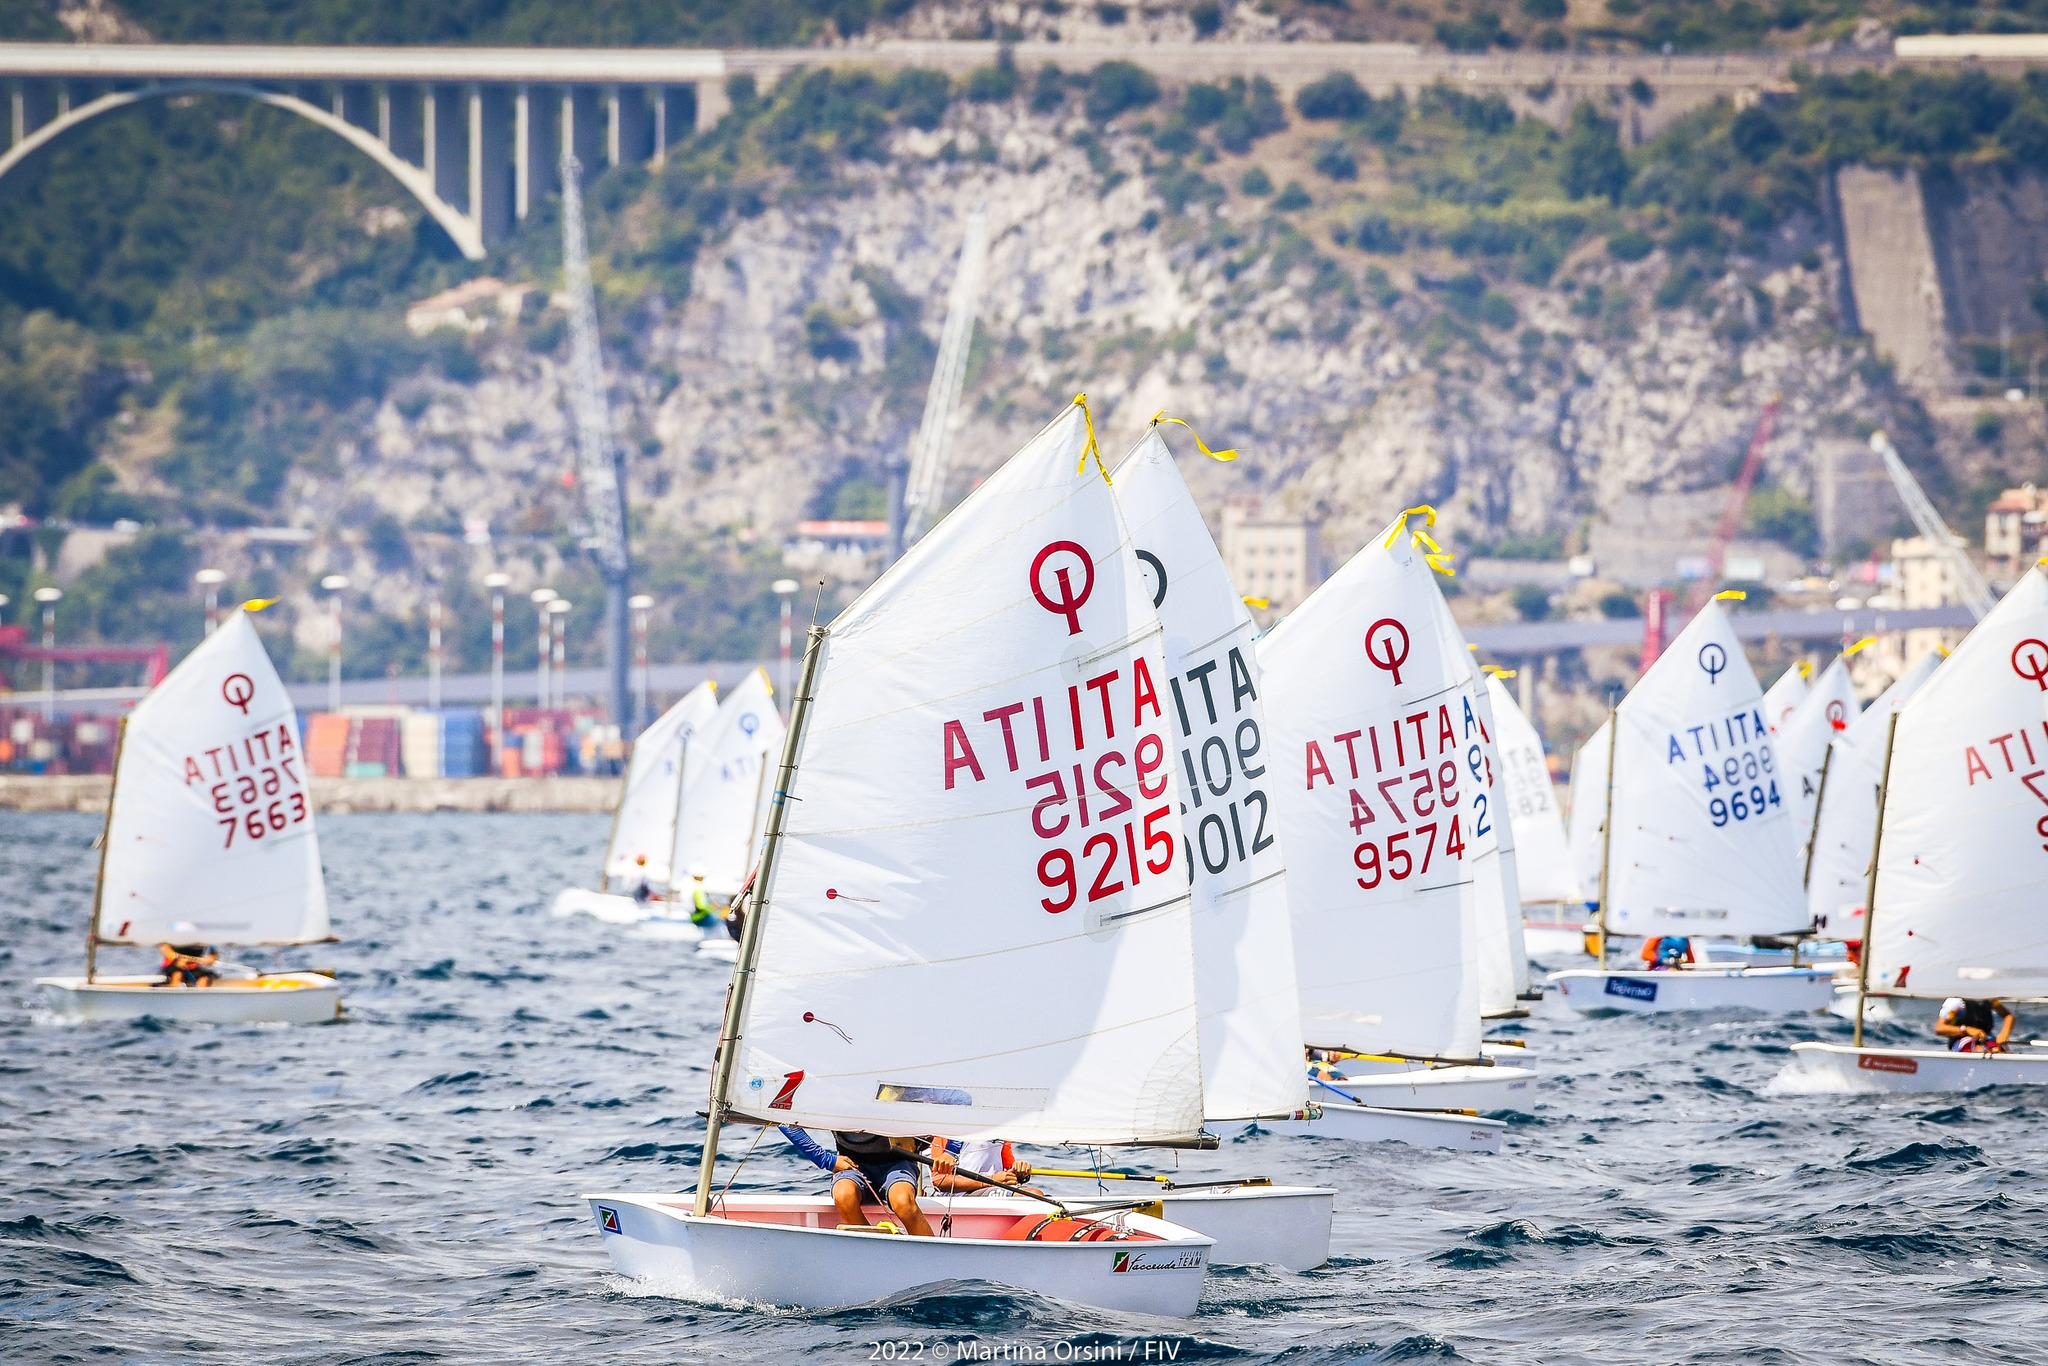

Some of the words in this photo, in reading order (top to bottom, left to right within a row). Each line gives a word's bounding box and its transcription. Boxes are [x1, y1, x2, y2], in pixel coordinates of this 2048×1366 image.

[1068, 656, 1162, 751] ITA
[1169, 646, 1258, 737] ITA
[244, 724, 295, 766] ITA
[1393, 704, 1456, 767] ITA
[1726, 708, 1767, 747] ITA
[219, 792, 306, 849] 7663
[1710, 779, 1781, 828] 9694
[1037, 805, 1174, 915] 9215
[1354, 814, 1466, 890] 9574
[1178, 1257, 1202, 1267] TEAM
